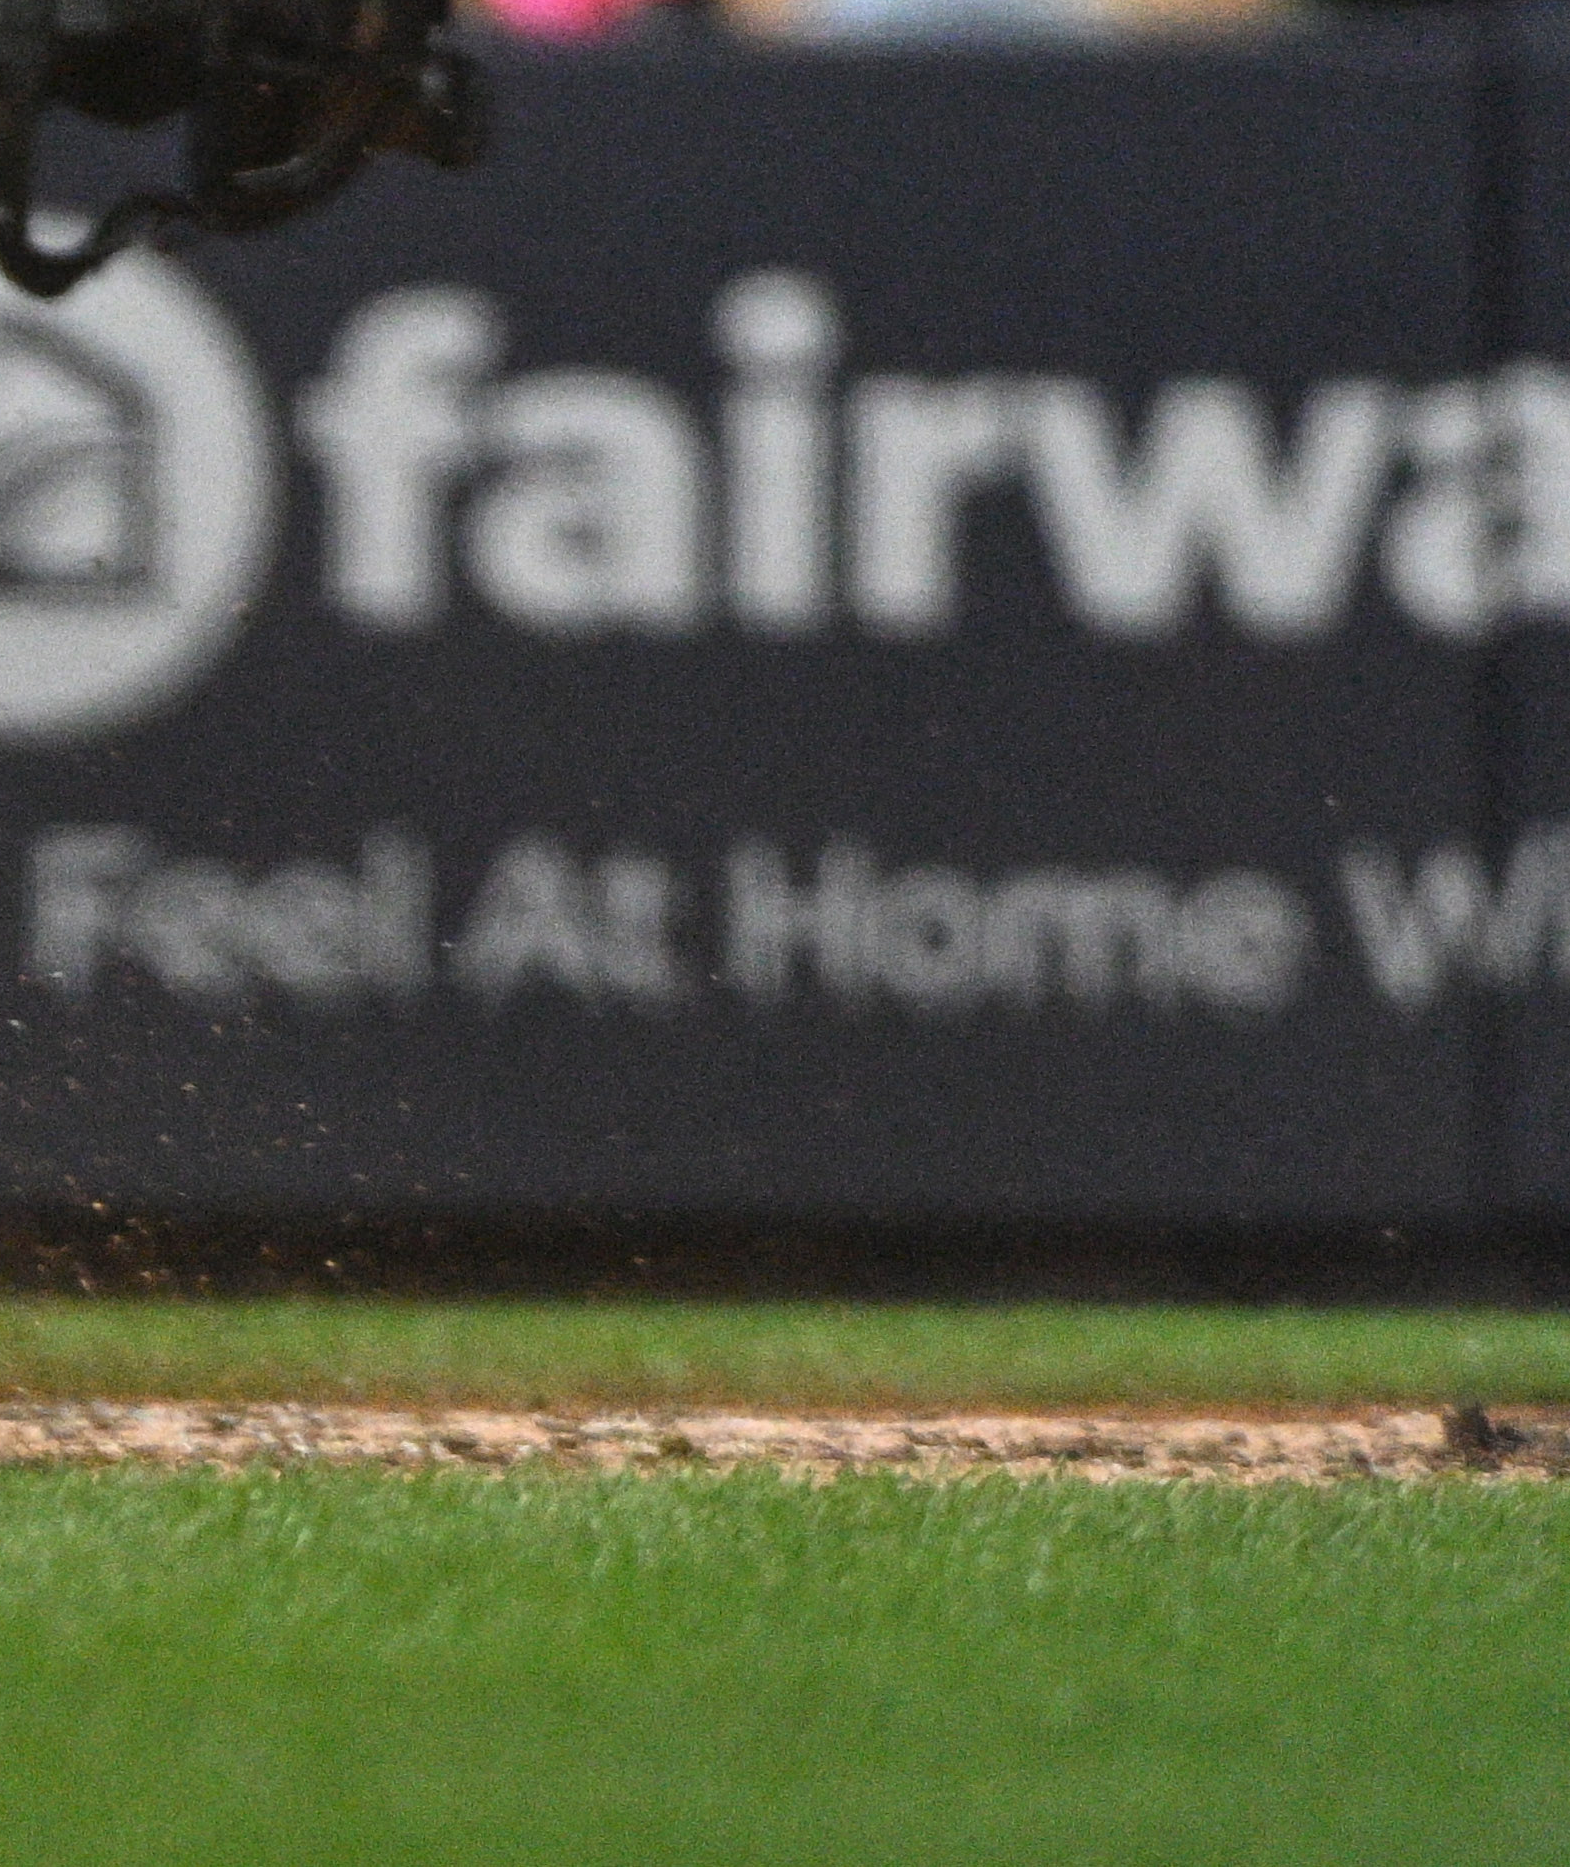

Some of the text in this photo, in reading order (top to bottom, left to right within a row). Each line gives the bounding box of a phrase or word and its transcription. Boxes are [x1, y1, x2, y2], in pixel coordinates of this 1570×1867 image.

[32, 824, 1570, 1006] Feel At Home W
